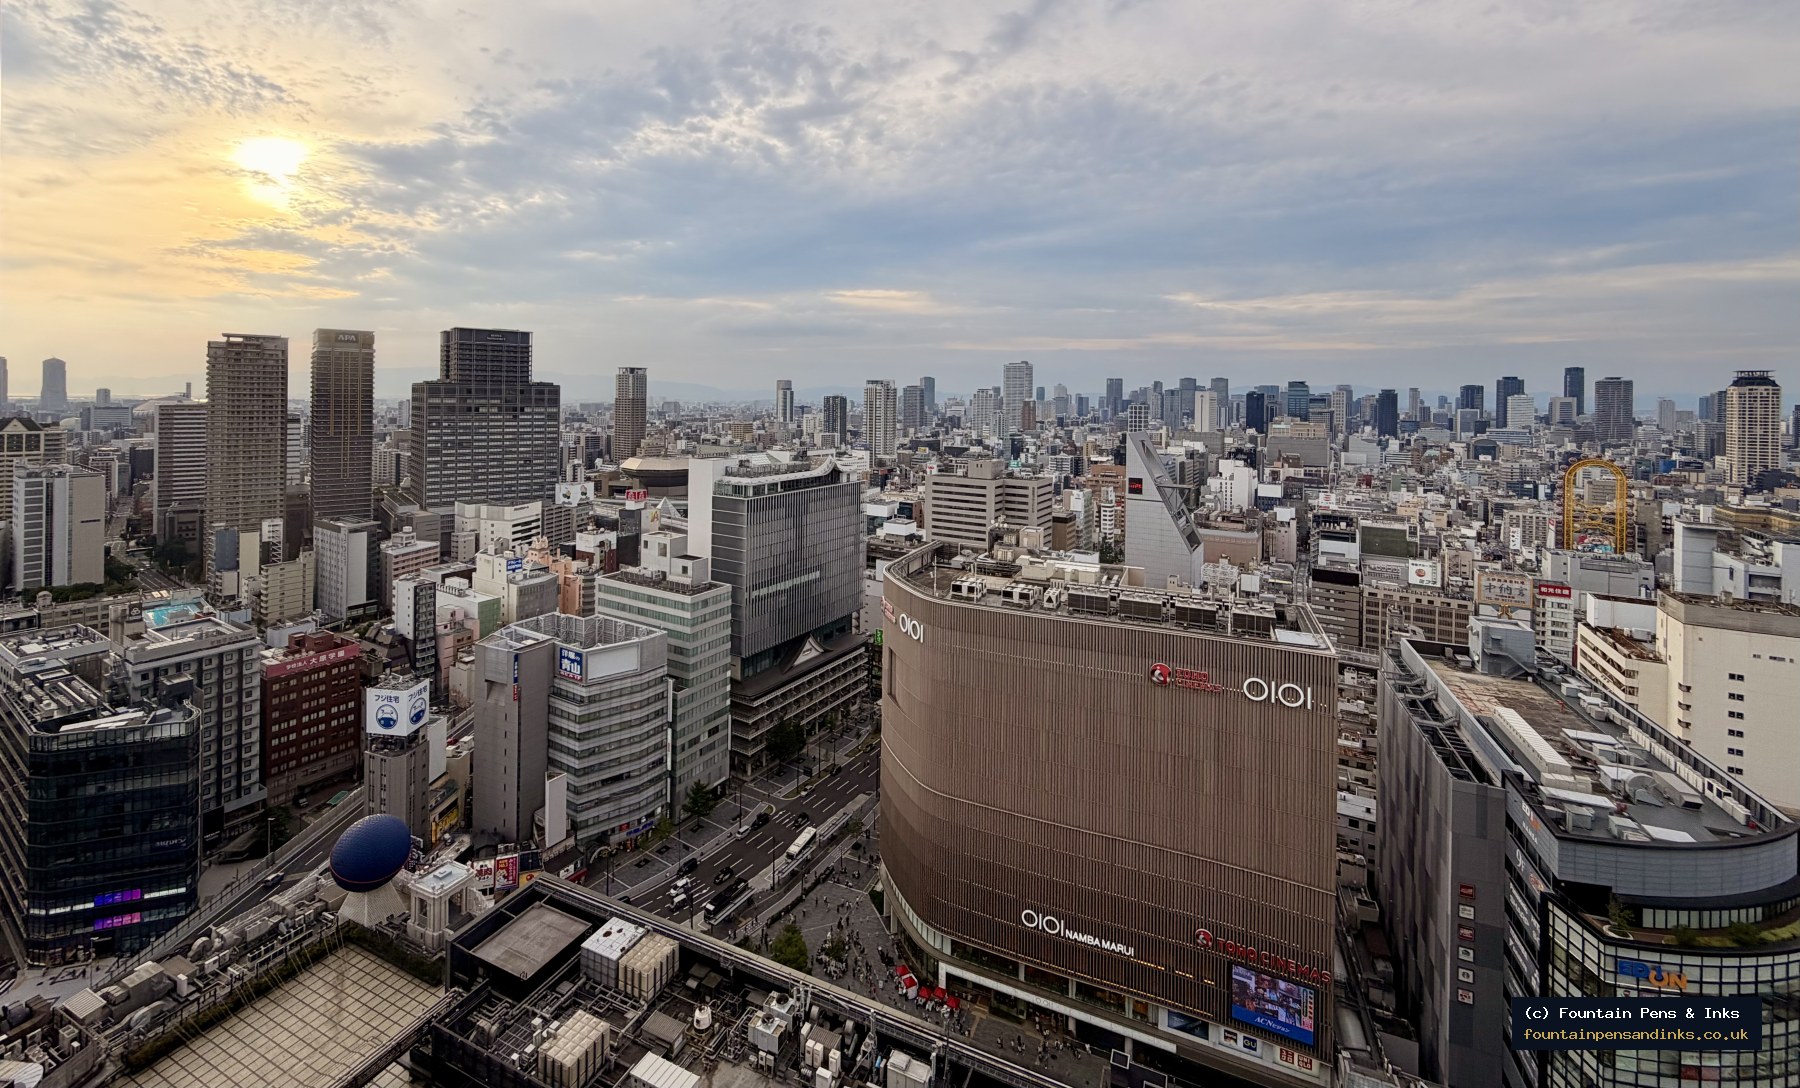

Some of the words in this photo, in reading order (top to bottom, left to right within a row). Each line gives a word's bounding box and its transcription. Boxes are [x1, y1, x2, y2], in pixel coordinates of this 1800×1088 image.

[1484, 583, 1527, 597] 中納言
[561, 658, 581, 675] 青山
[374, 694, 399, 704] フジ住宅
[408, 685, 428, 702] フジ住宅
[1065, 929, 1101, 947] NAMBA
[1101, 939, 1134, 957] MARUI
[1217, 937, 1258, 961] TOHO
[1261, 951, 1331, 984] CINEMAS
[1243, 1039, 1257, 1048] GU
